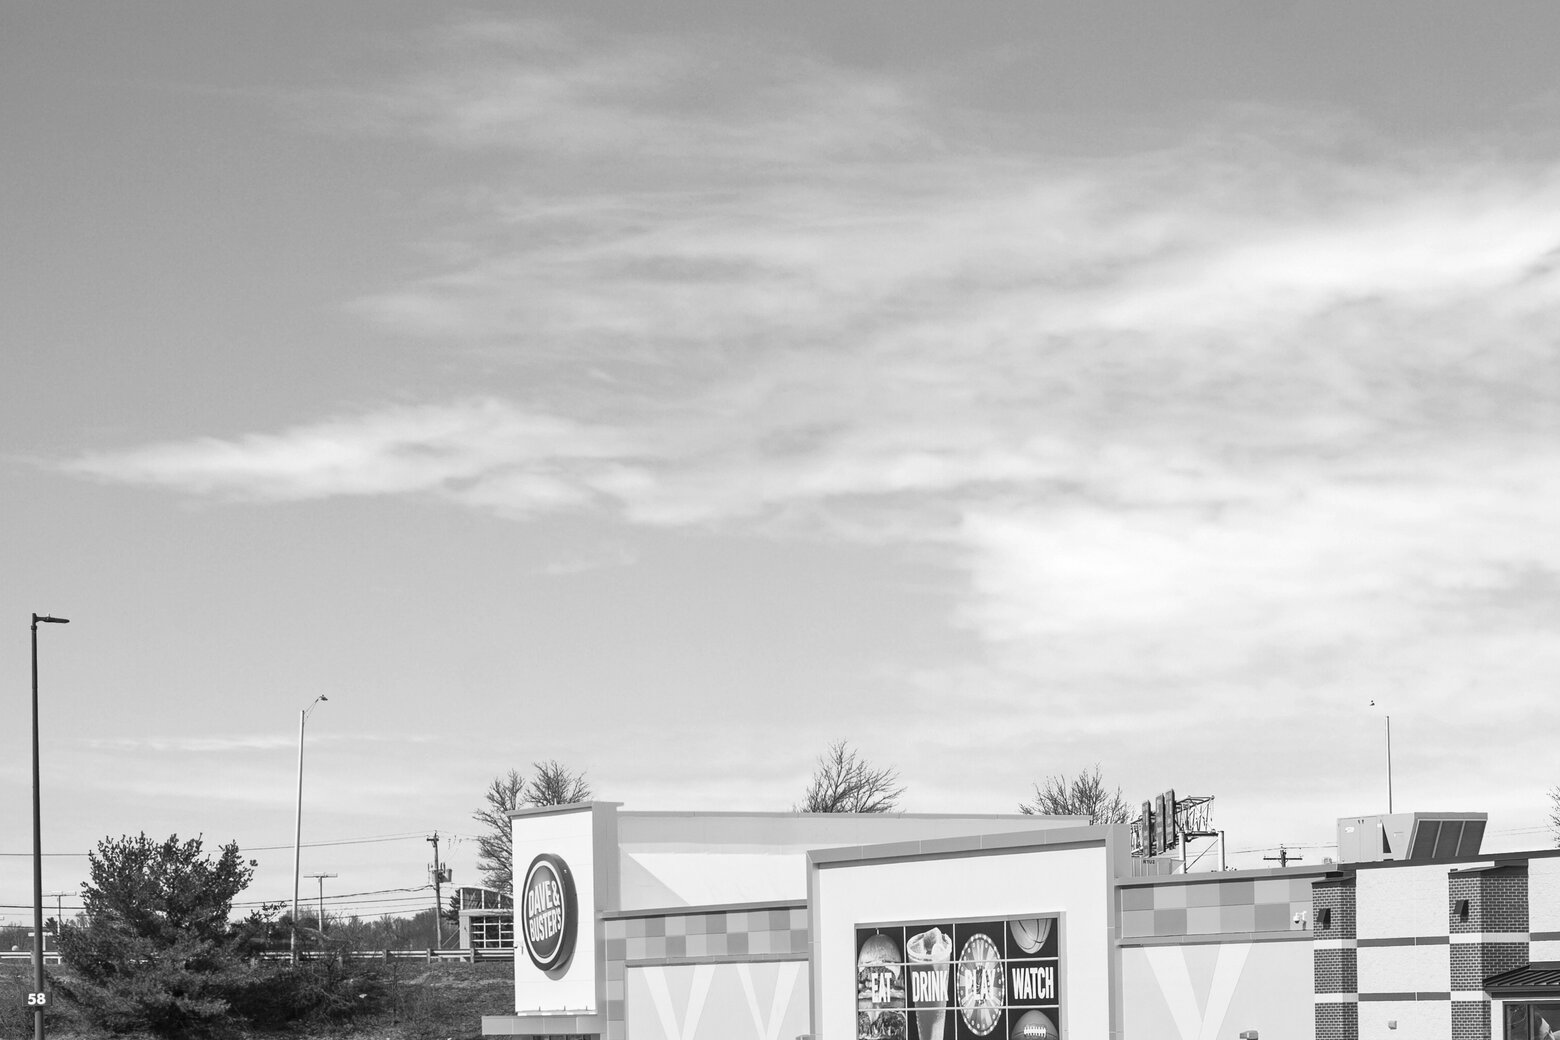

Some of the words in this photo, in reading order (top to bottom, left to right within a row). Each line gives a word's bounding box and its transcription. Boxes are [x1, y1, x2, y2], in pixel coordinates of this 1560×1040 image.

[528, 880, 553, 918] DAVE
[551, 880, 561, 907] &
[529, 906, 562, 942] BUSTER'S
[27, 992, 46, 1005] 58
[871, 972, 892, 1003] EAT
[912, 970, 949, 1003] DRINK
[965, 968, 997, 1000] PLAY
[1012, 966, 1055, 1000] WATCH
